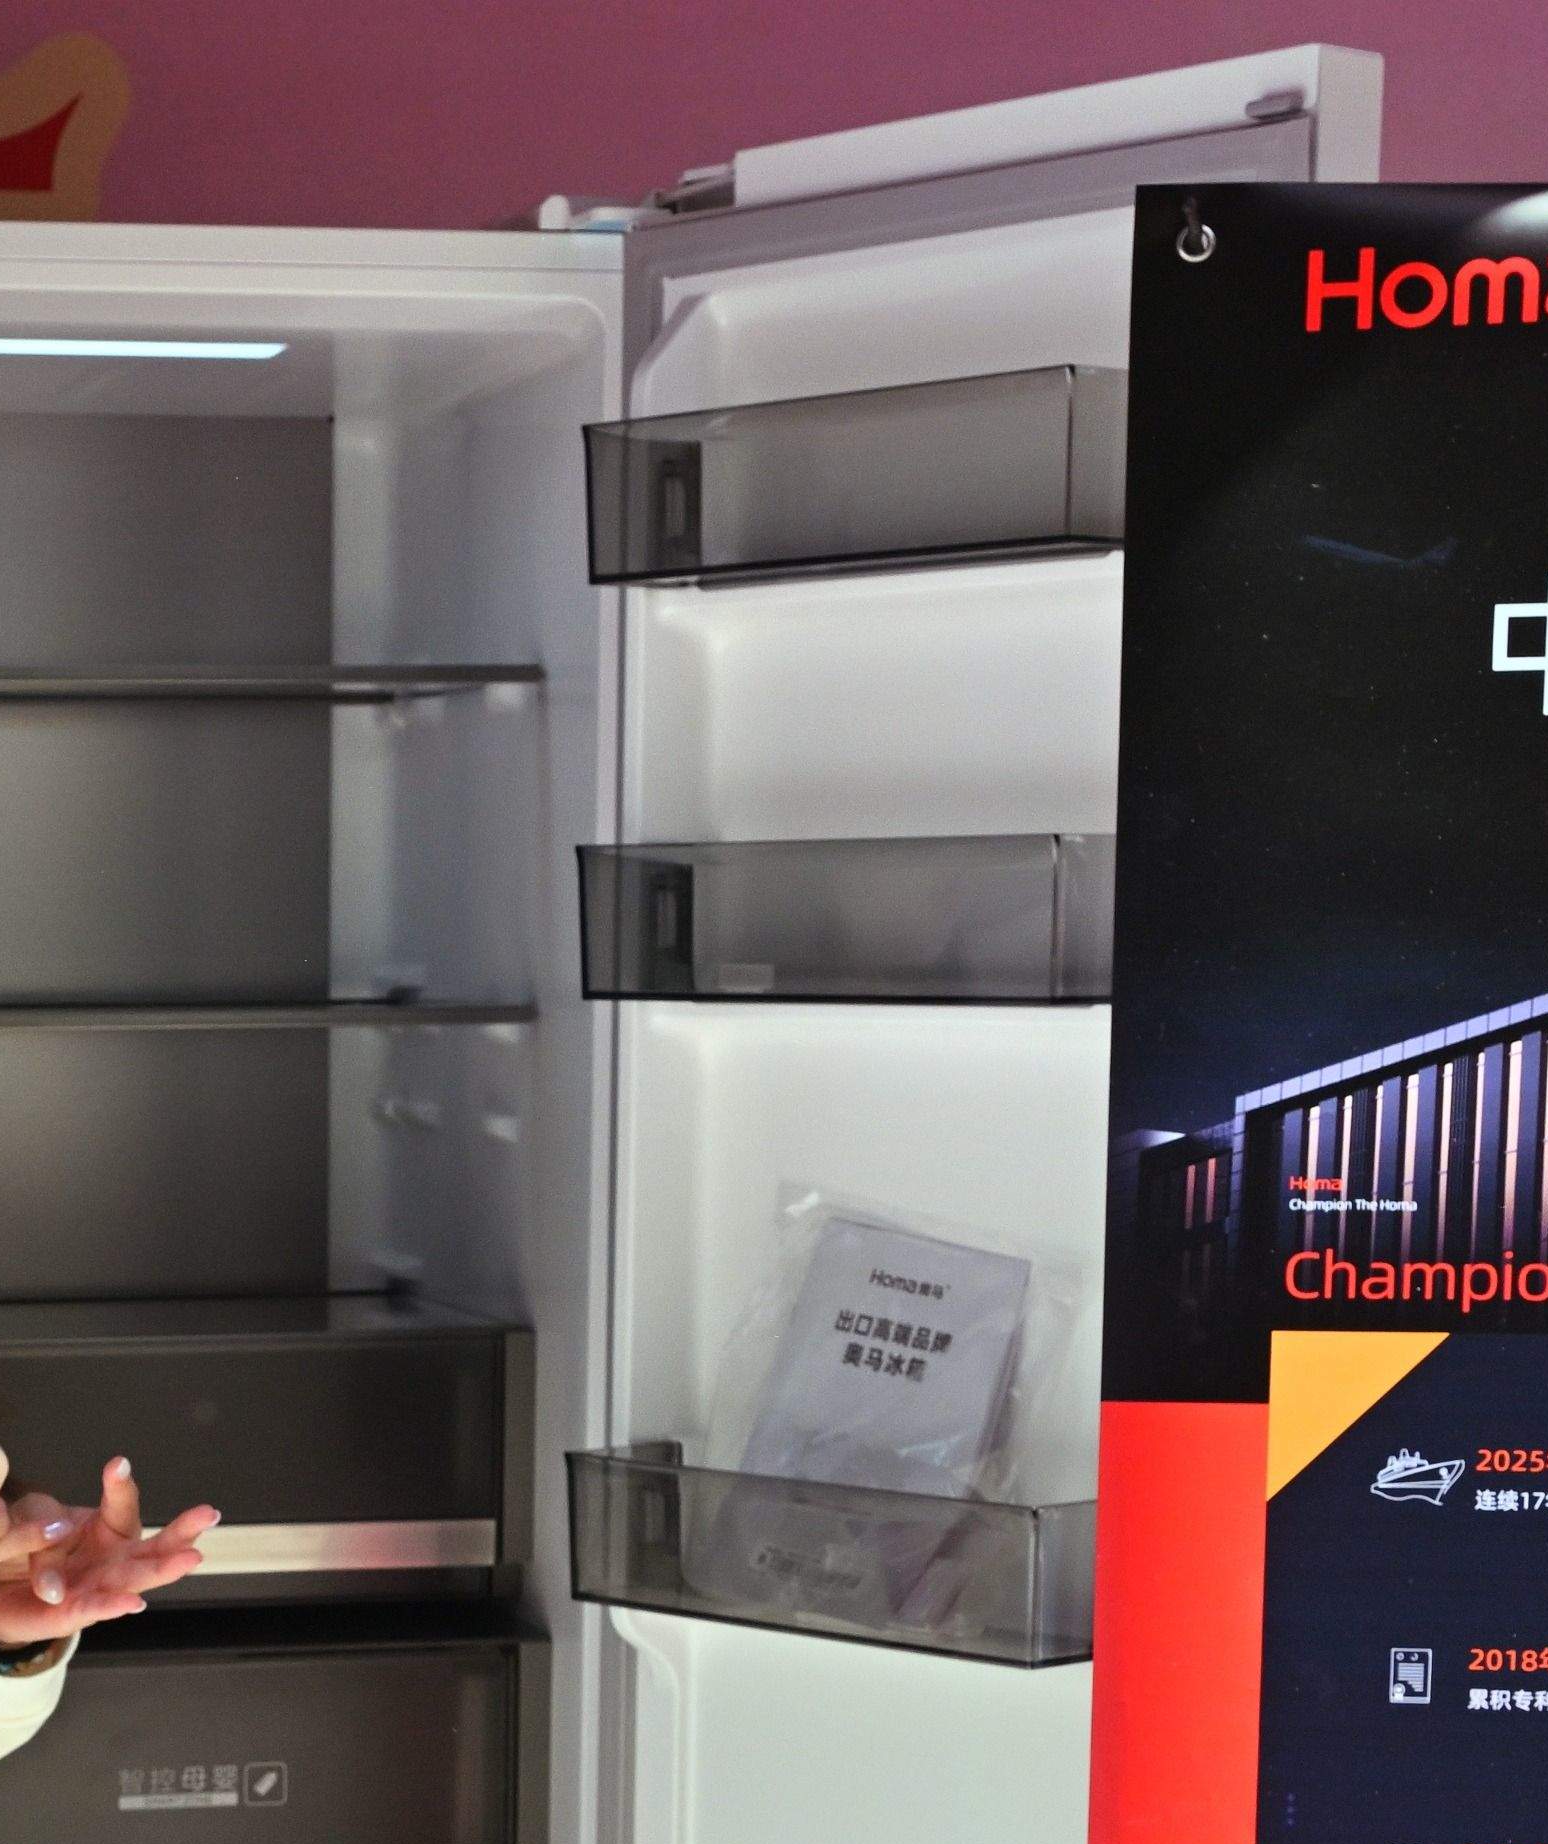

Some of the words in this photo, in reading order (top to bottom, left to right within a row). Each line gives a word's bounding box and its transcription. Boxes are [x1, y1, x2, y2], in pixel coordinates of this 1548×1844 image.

[1289, 1175, 1343, 1191] Homa
[1289, 1198, 1353, 1212] Champion
[1355, 1198, 1378, 1211] The
[1379, 1199, 1418, 1212] Homa
